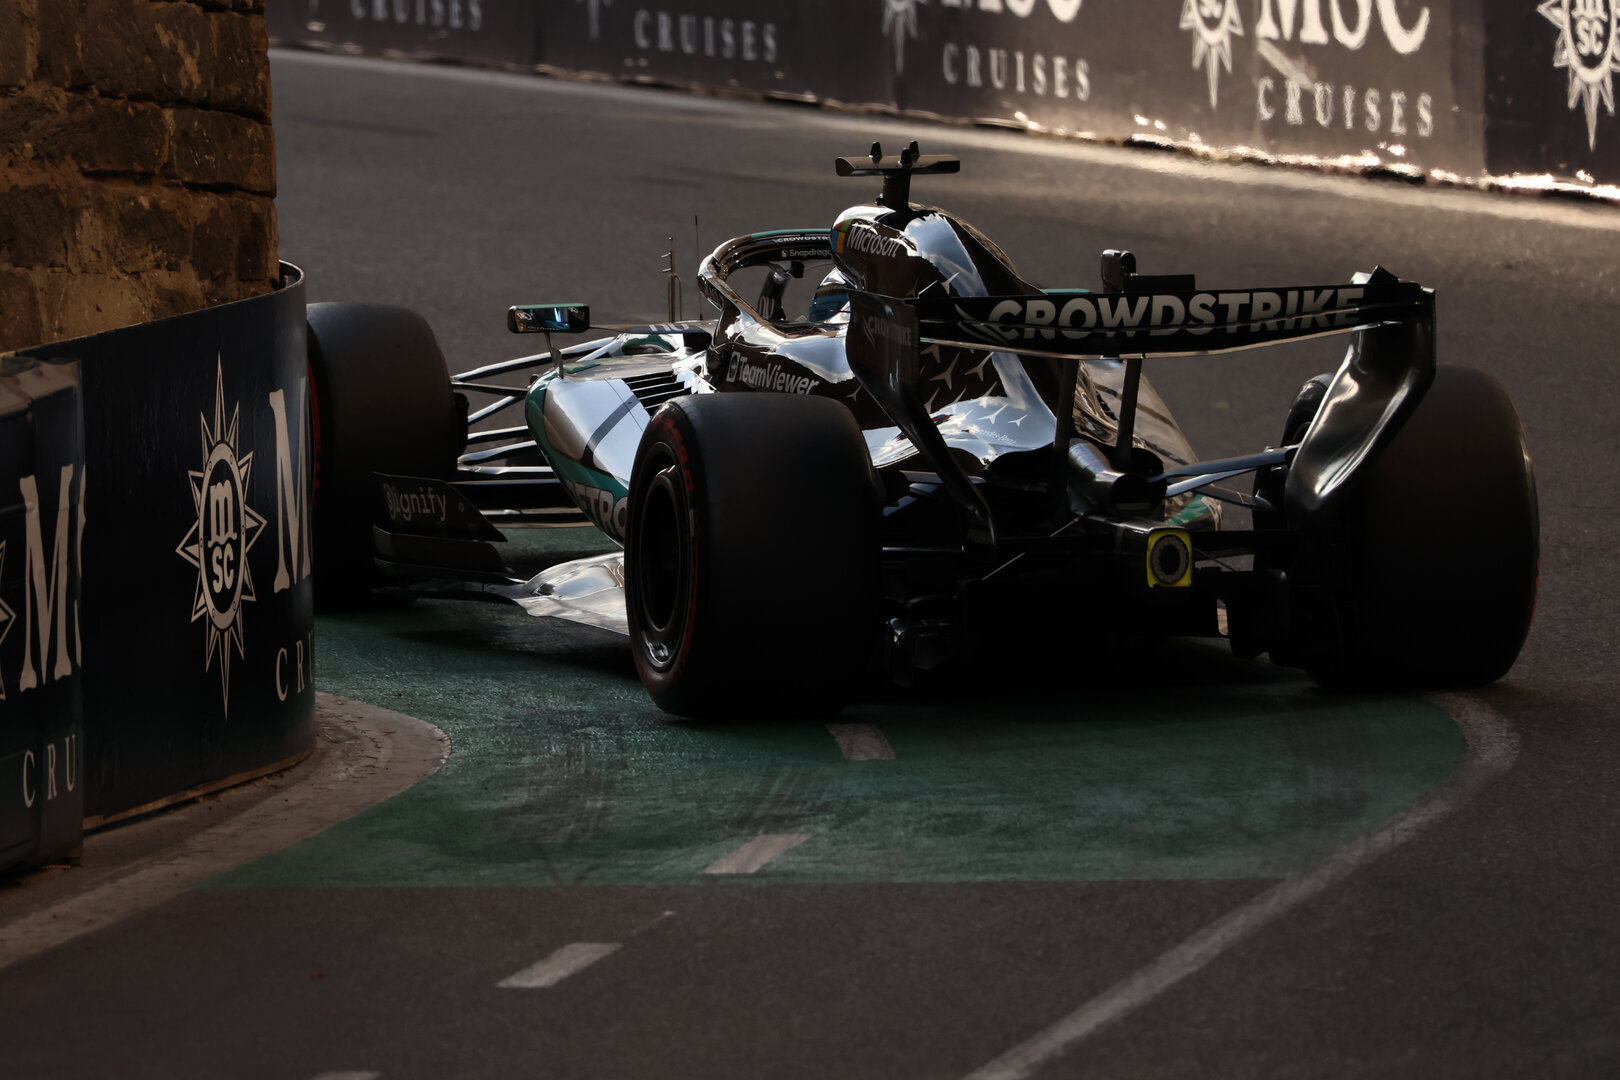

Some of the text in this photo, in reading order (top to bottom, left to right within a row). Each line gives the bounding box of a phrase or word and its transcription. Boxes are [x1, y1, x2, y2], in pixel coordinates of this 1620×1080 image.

[633, 8, 777, 63] CRUISES
[941, 42, 1090, 101] CRUISES
[1256, 77, 1433, 137] CRUISES
[986, 287, 1365, 341] CROWDSTRIKE
[738, 356, 820, 395] TeamViewer
